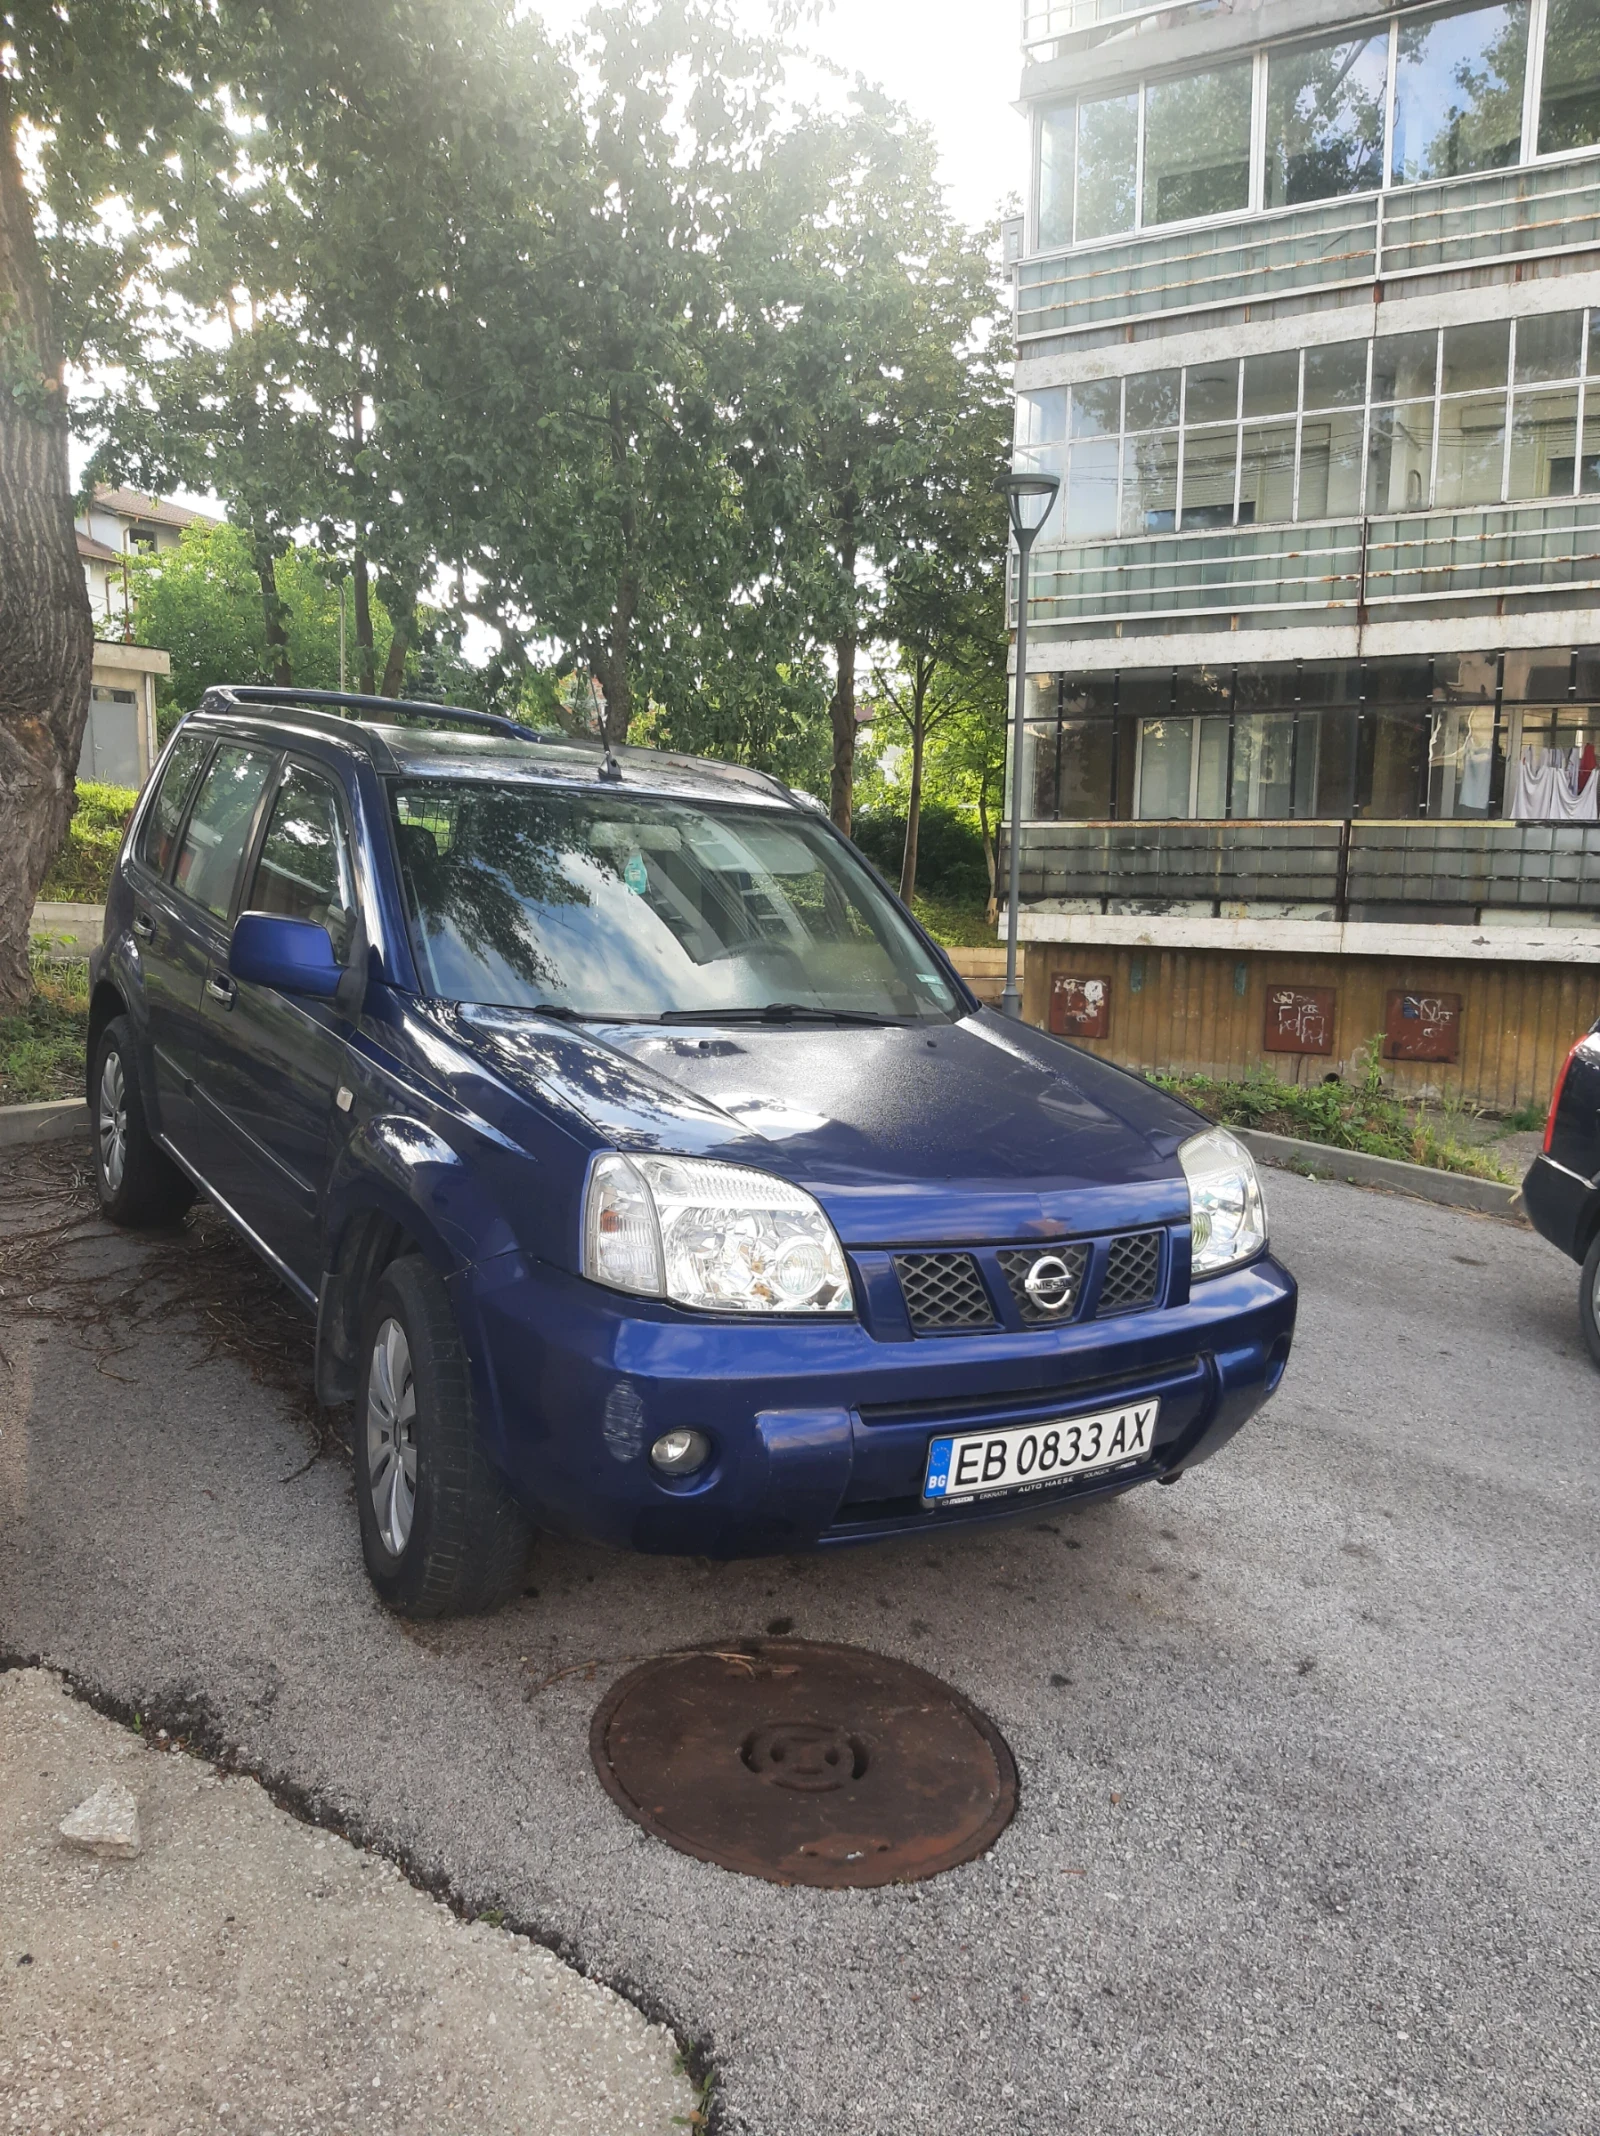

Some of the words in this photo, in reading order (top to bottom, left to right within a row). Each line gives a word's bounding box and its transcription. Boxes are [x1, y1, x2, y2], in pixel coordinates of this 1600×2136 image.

[1033, 1278, 1072, 1291] NISSAN
[954, 1440, 1007, 1486] EB
[1017, 1422, 1103, 1476] 0833
[1107, 1408, 1151, 1457] AX
[928, 1475, 947, 1489] BG
[1018, 1483, 1042, 1493] AUTO
[1044, 1476, 1074, 1488] HAESE
